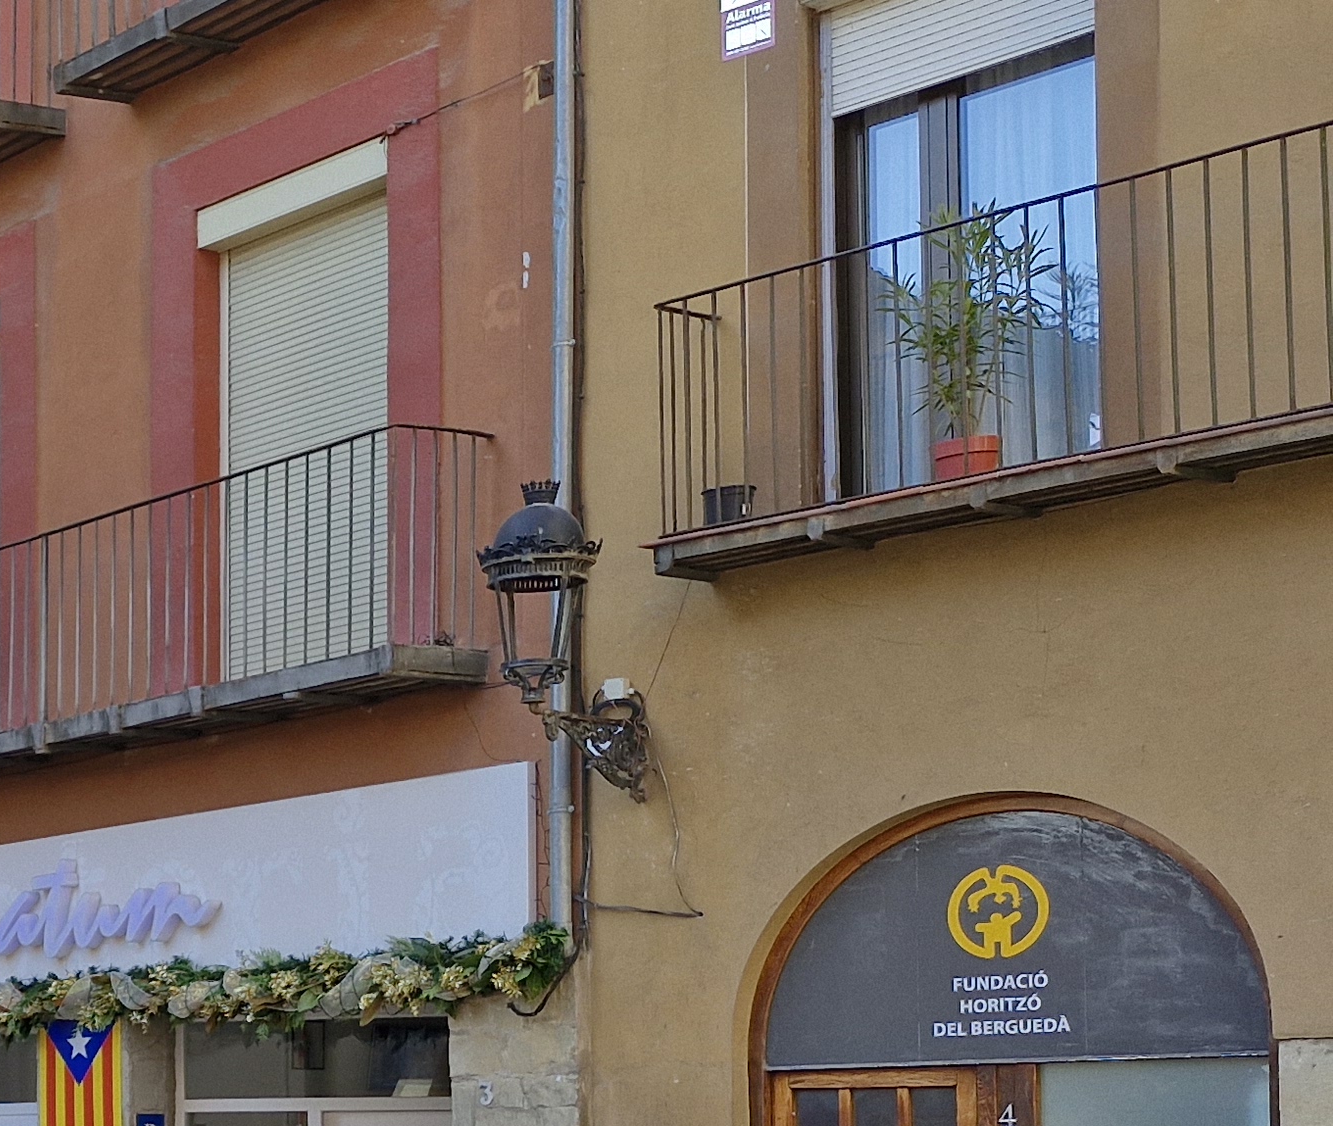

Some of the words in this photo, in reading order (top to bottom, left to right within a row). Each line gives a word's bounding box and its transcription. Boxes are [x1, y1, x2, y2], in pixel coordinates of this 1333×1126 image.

[726, 1, 771, 25] Alarma
[952, 969, 1049, 993] FUNDACIÓ
[959, 993, 1042, 1014] HORITZÓ
[933, 1021, 968, 1038] DEL
[971, 1014, 1071, 1036] BERGUEDÀ
[478, 1080, 494, 1106] 3
